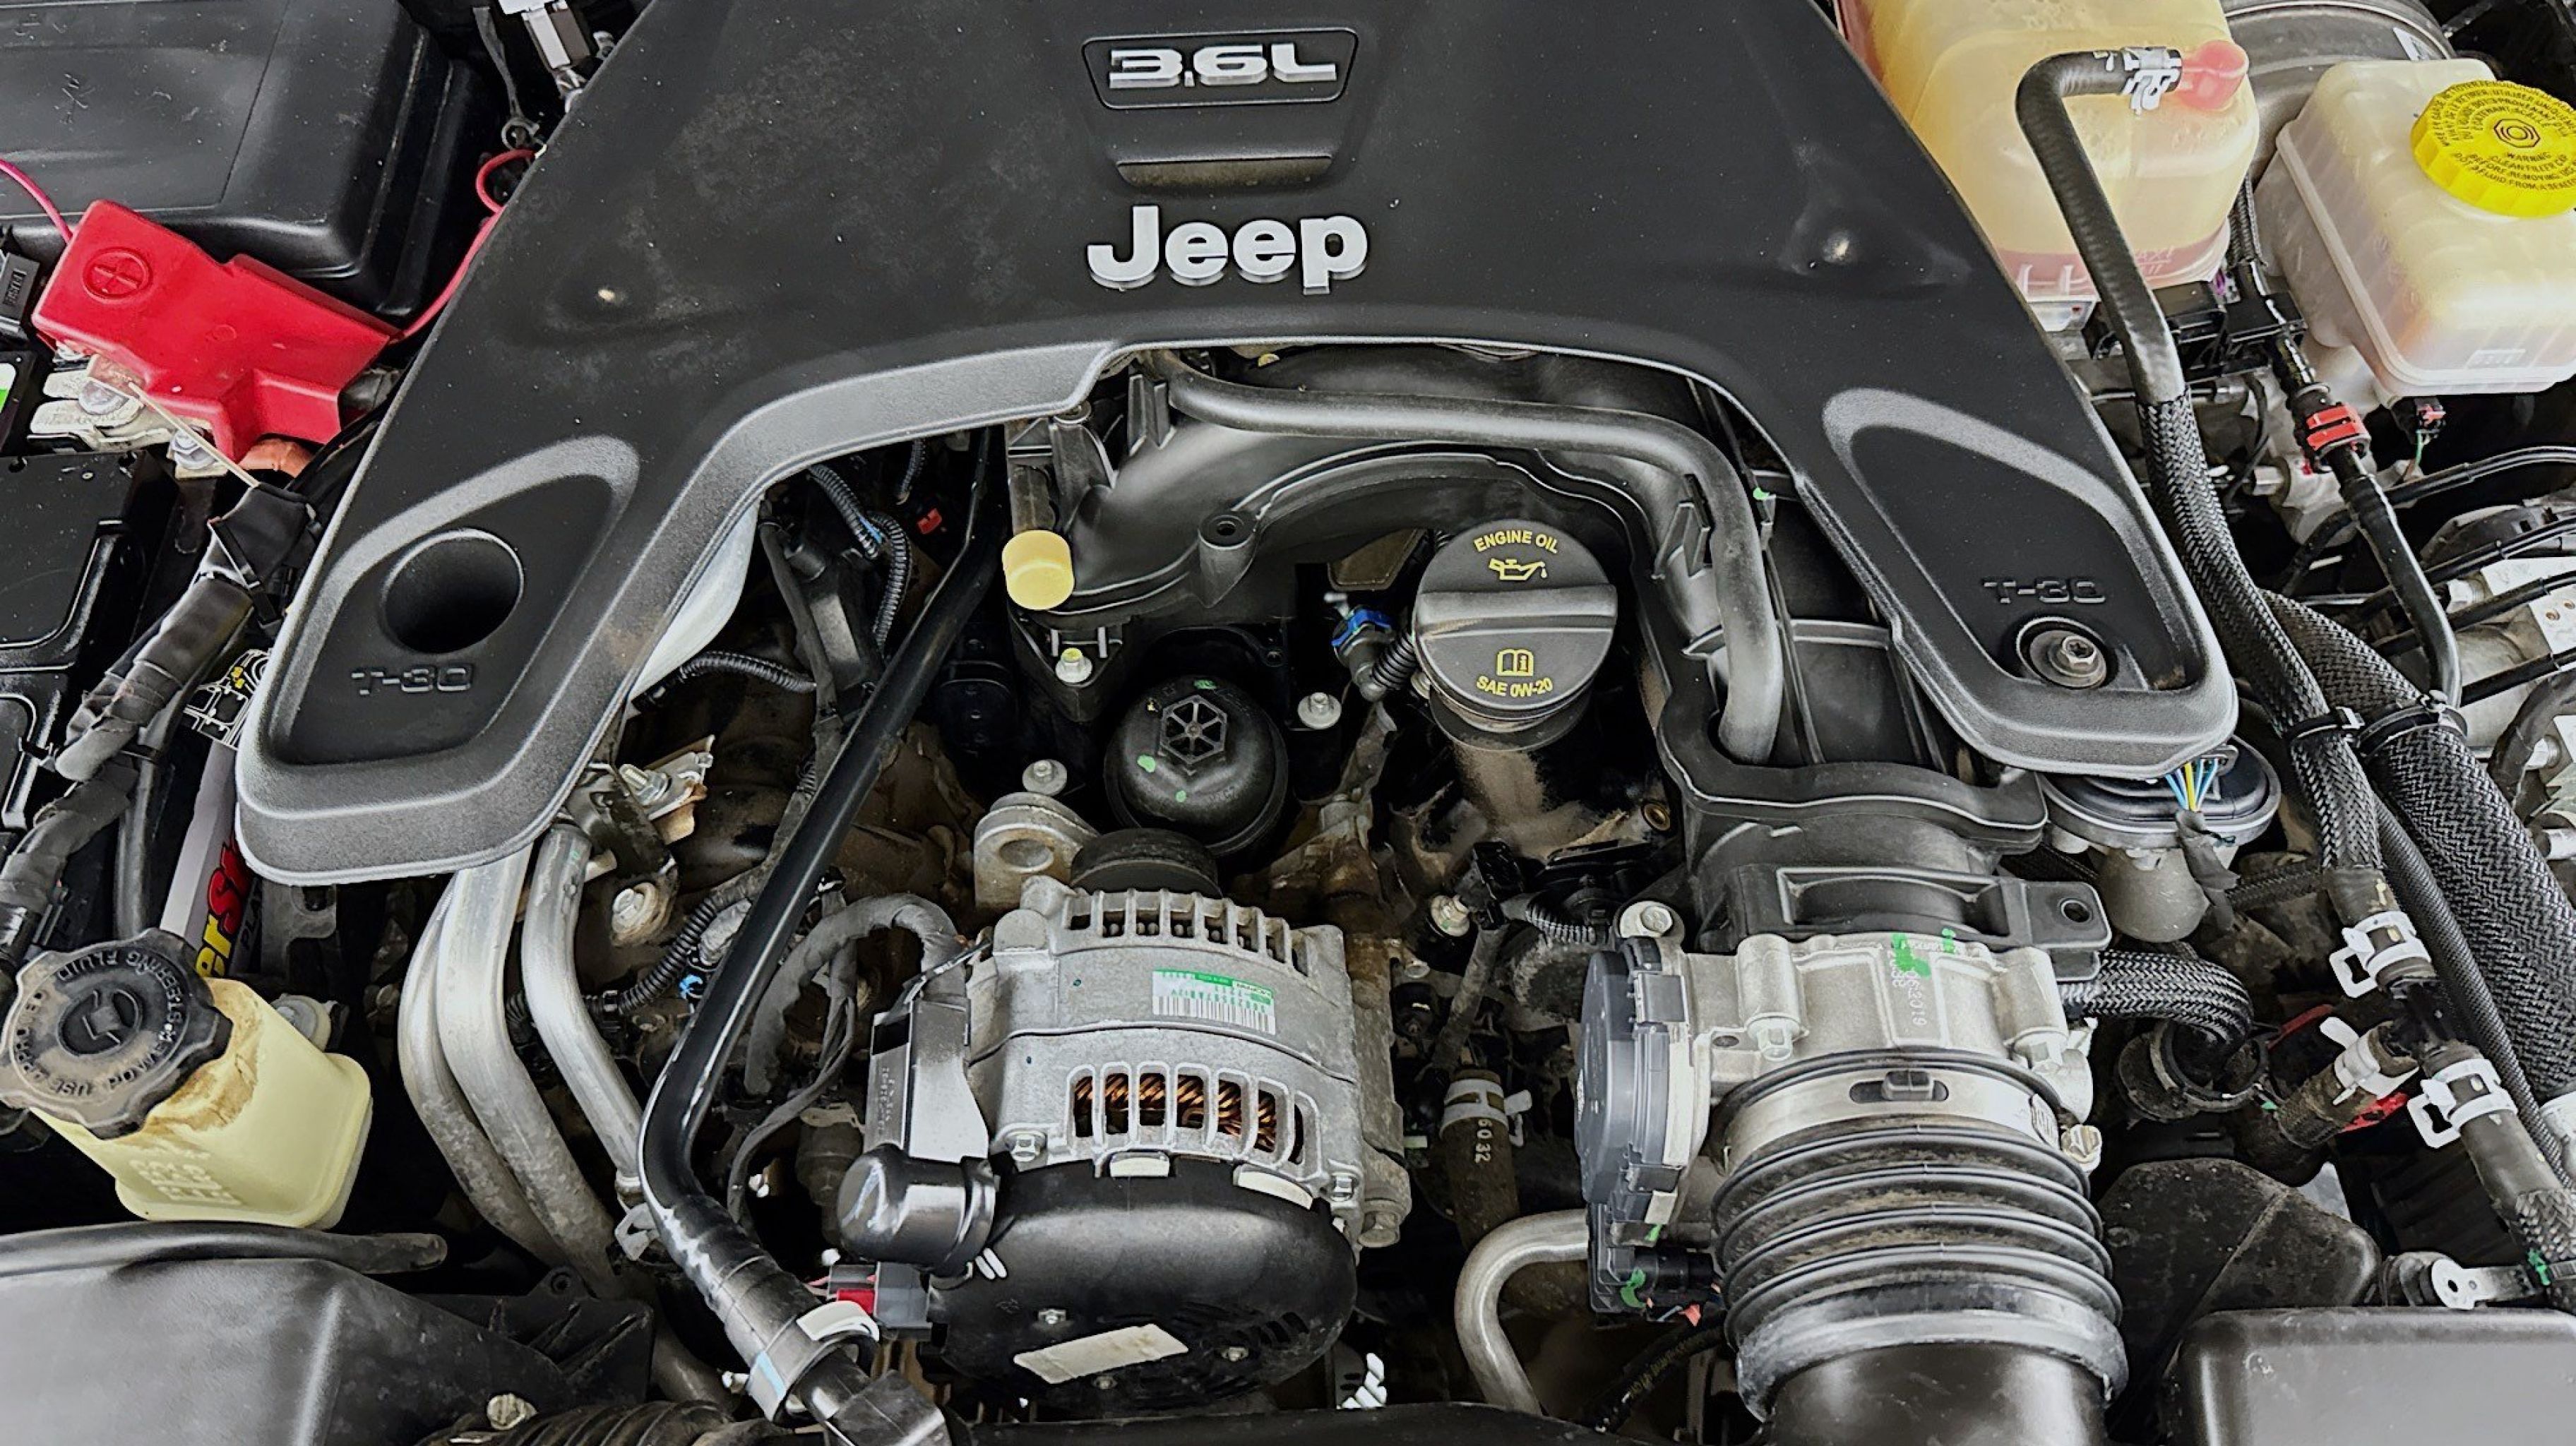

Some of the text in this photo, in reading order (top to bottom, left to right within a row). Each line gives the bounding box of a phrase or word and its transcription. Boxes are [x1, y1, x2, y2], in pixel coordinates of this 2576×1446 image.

[1108, 42, 1337, 89] 3.6L
[1087, 205, 1368, 295] Jeep
[1474, 530, 1557, 554] ENGINE OIL
[1982, 576, 2106, 604] T-30
[351, 664, 474, 696] T-30
[1477, 675, 1553, 698] SAE 0W-20
[56, 950, 120, 982] FLUID
